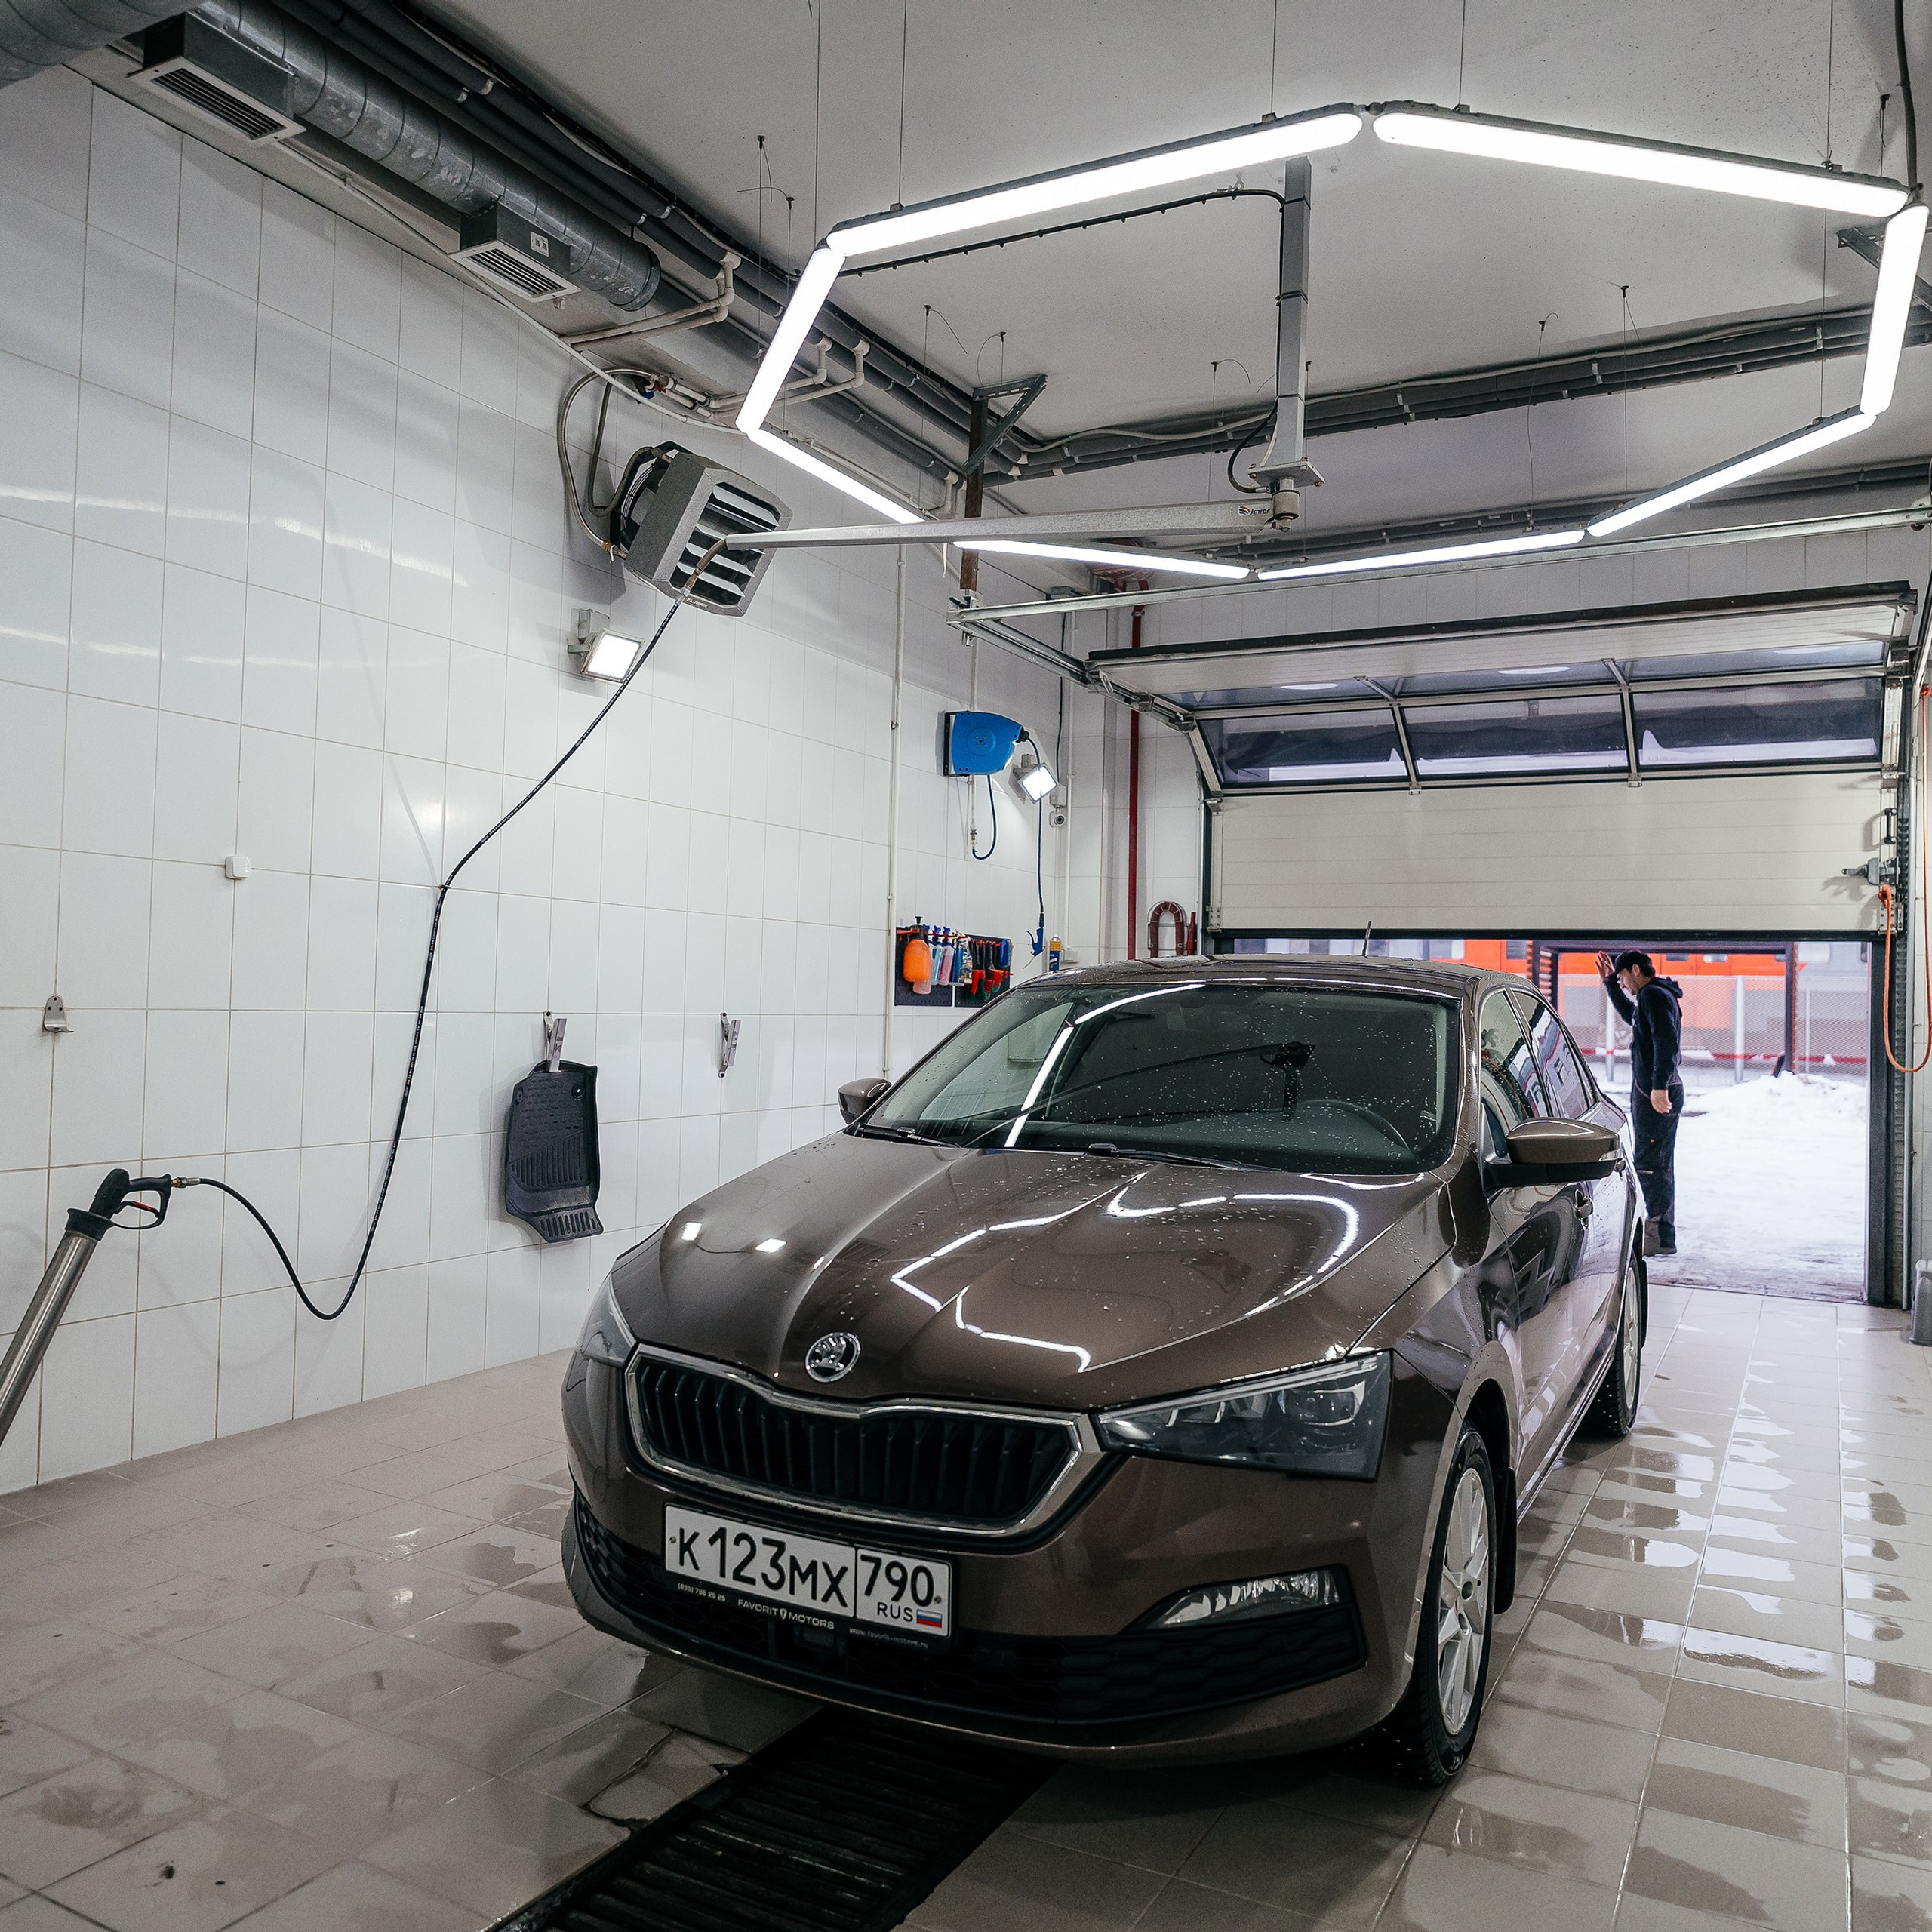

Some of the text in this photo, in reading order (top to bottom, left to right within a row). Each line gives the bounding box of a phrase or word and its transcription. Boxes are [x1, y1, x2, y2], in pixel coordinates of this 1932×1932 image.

[860, 1555, 934, 1607] 790
[737, 1599, 779, 1616] FAVORIT
[789, 1611, 835, 1629] MOTORS
[876, 1602, 914, 1622] RUS
